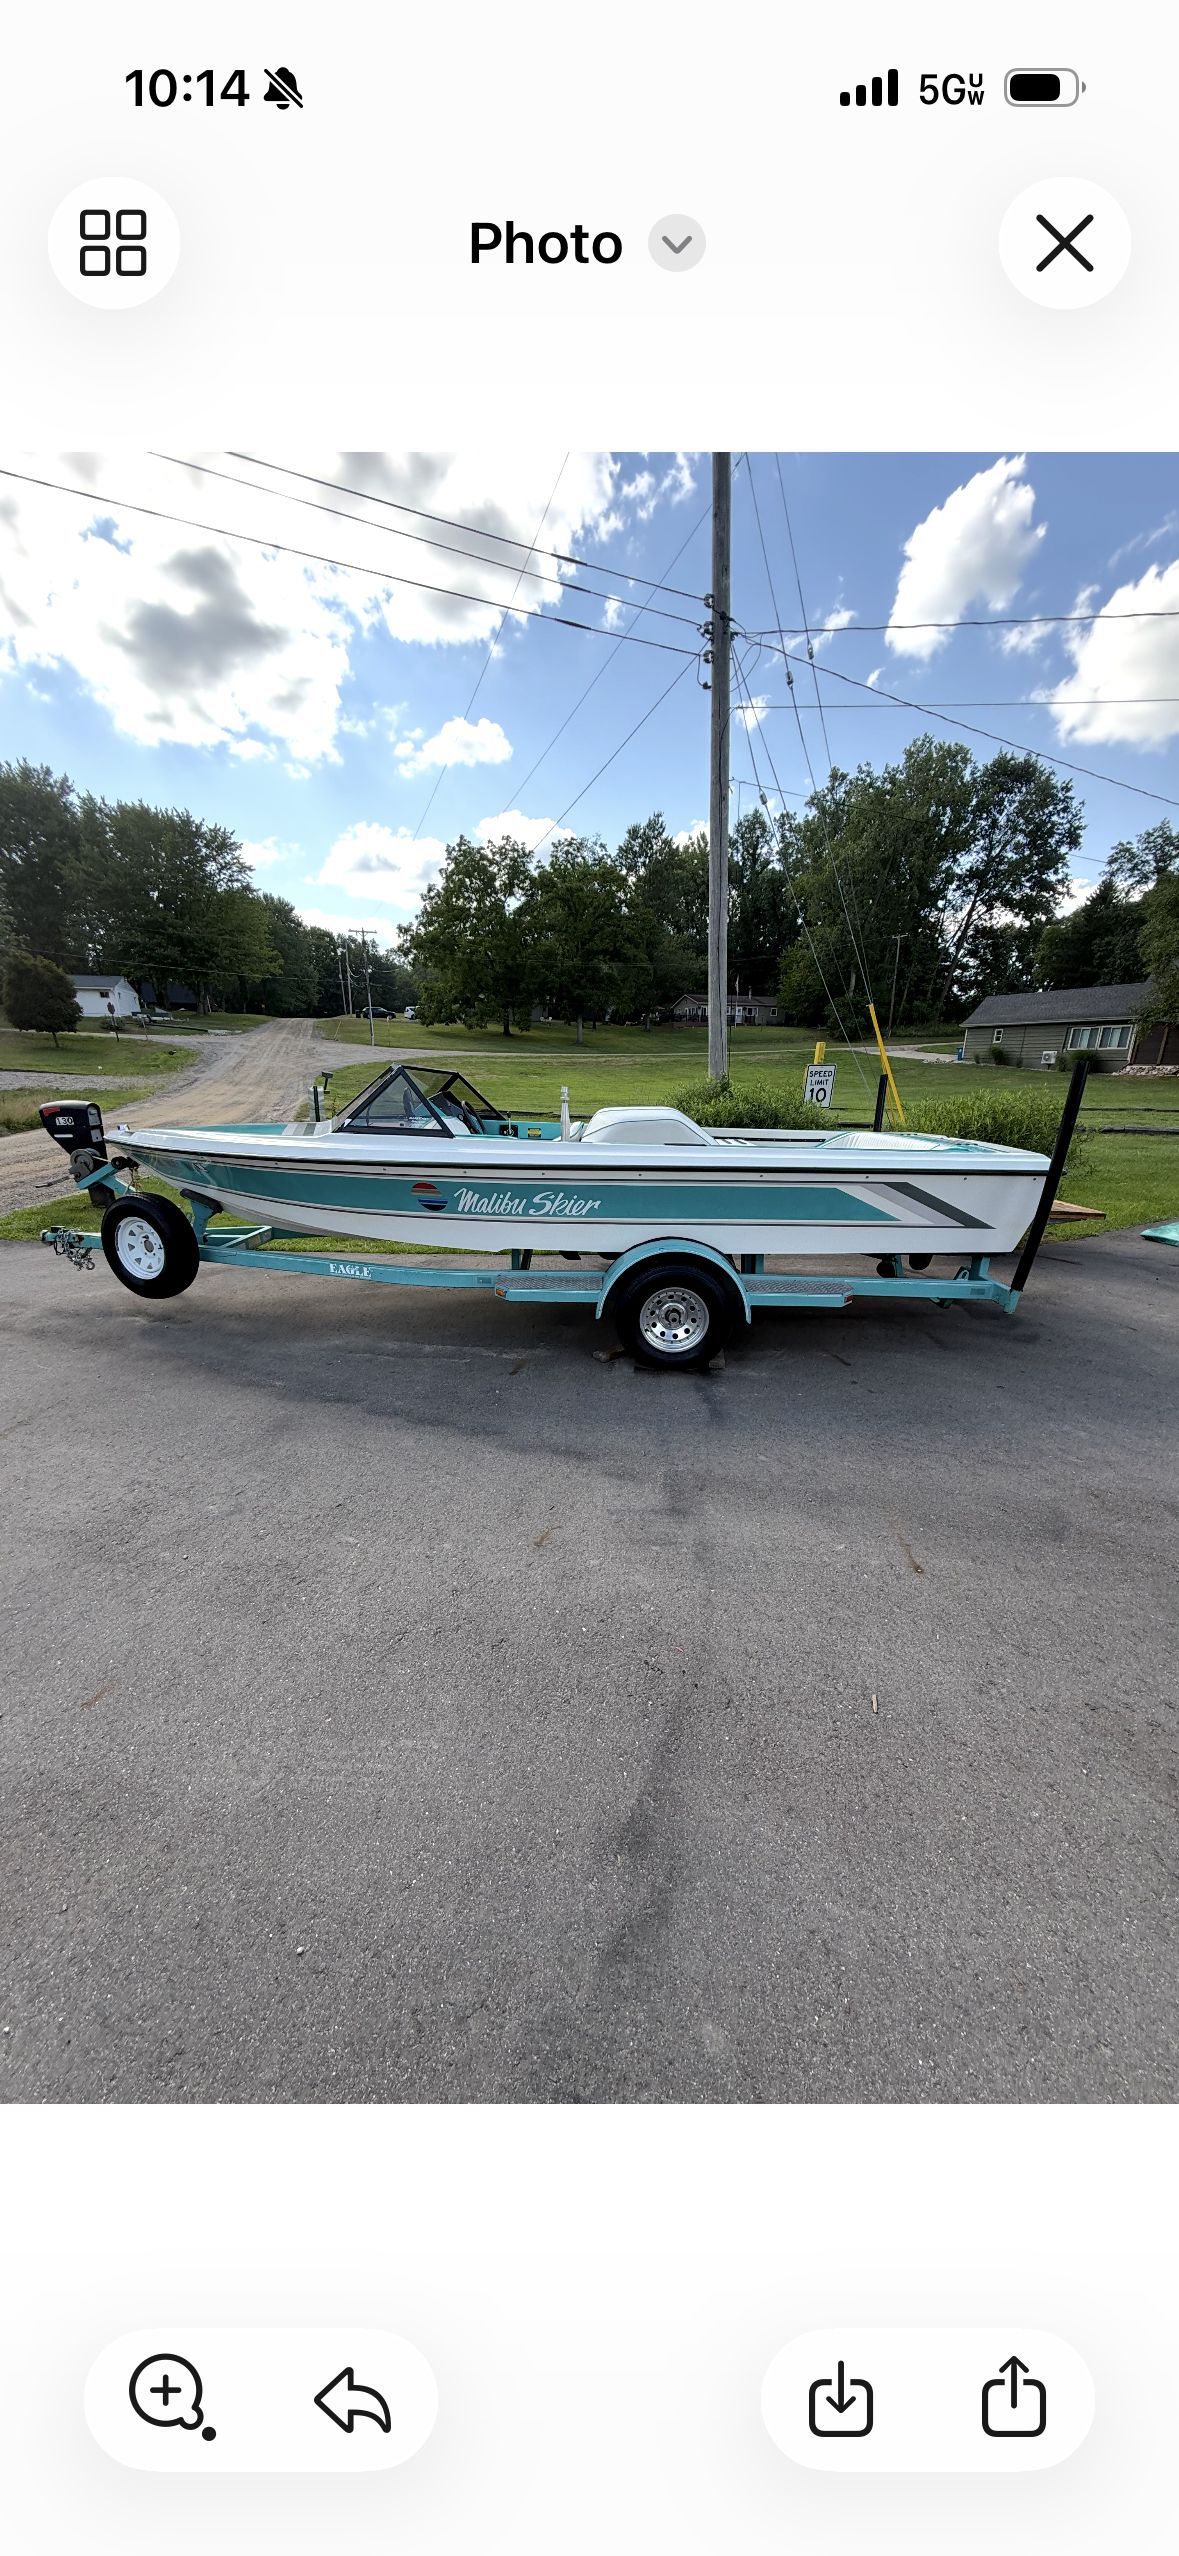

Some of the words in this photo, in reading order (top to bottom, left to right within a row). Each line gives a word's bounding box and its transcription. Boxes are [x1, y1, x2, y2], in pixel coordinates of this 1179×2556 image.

[809, 1070, 833, 1078] SPEED
[809, 1079, 829, 1087] LIMIT
[809, 1087, 827, 1103] 10
[453, 1187, 526, 1215] Malibu
[528, 1191, 602, 1216] Skier
[329, 1263, 372, 1278] EAGLE
